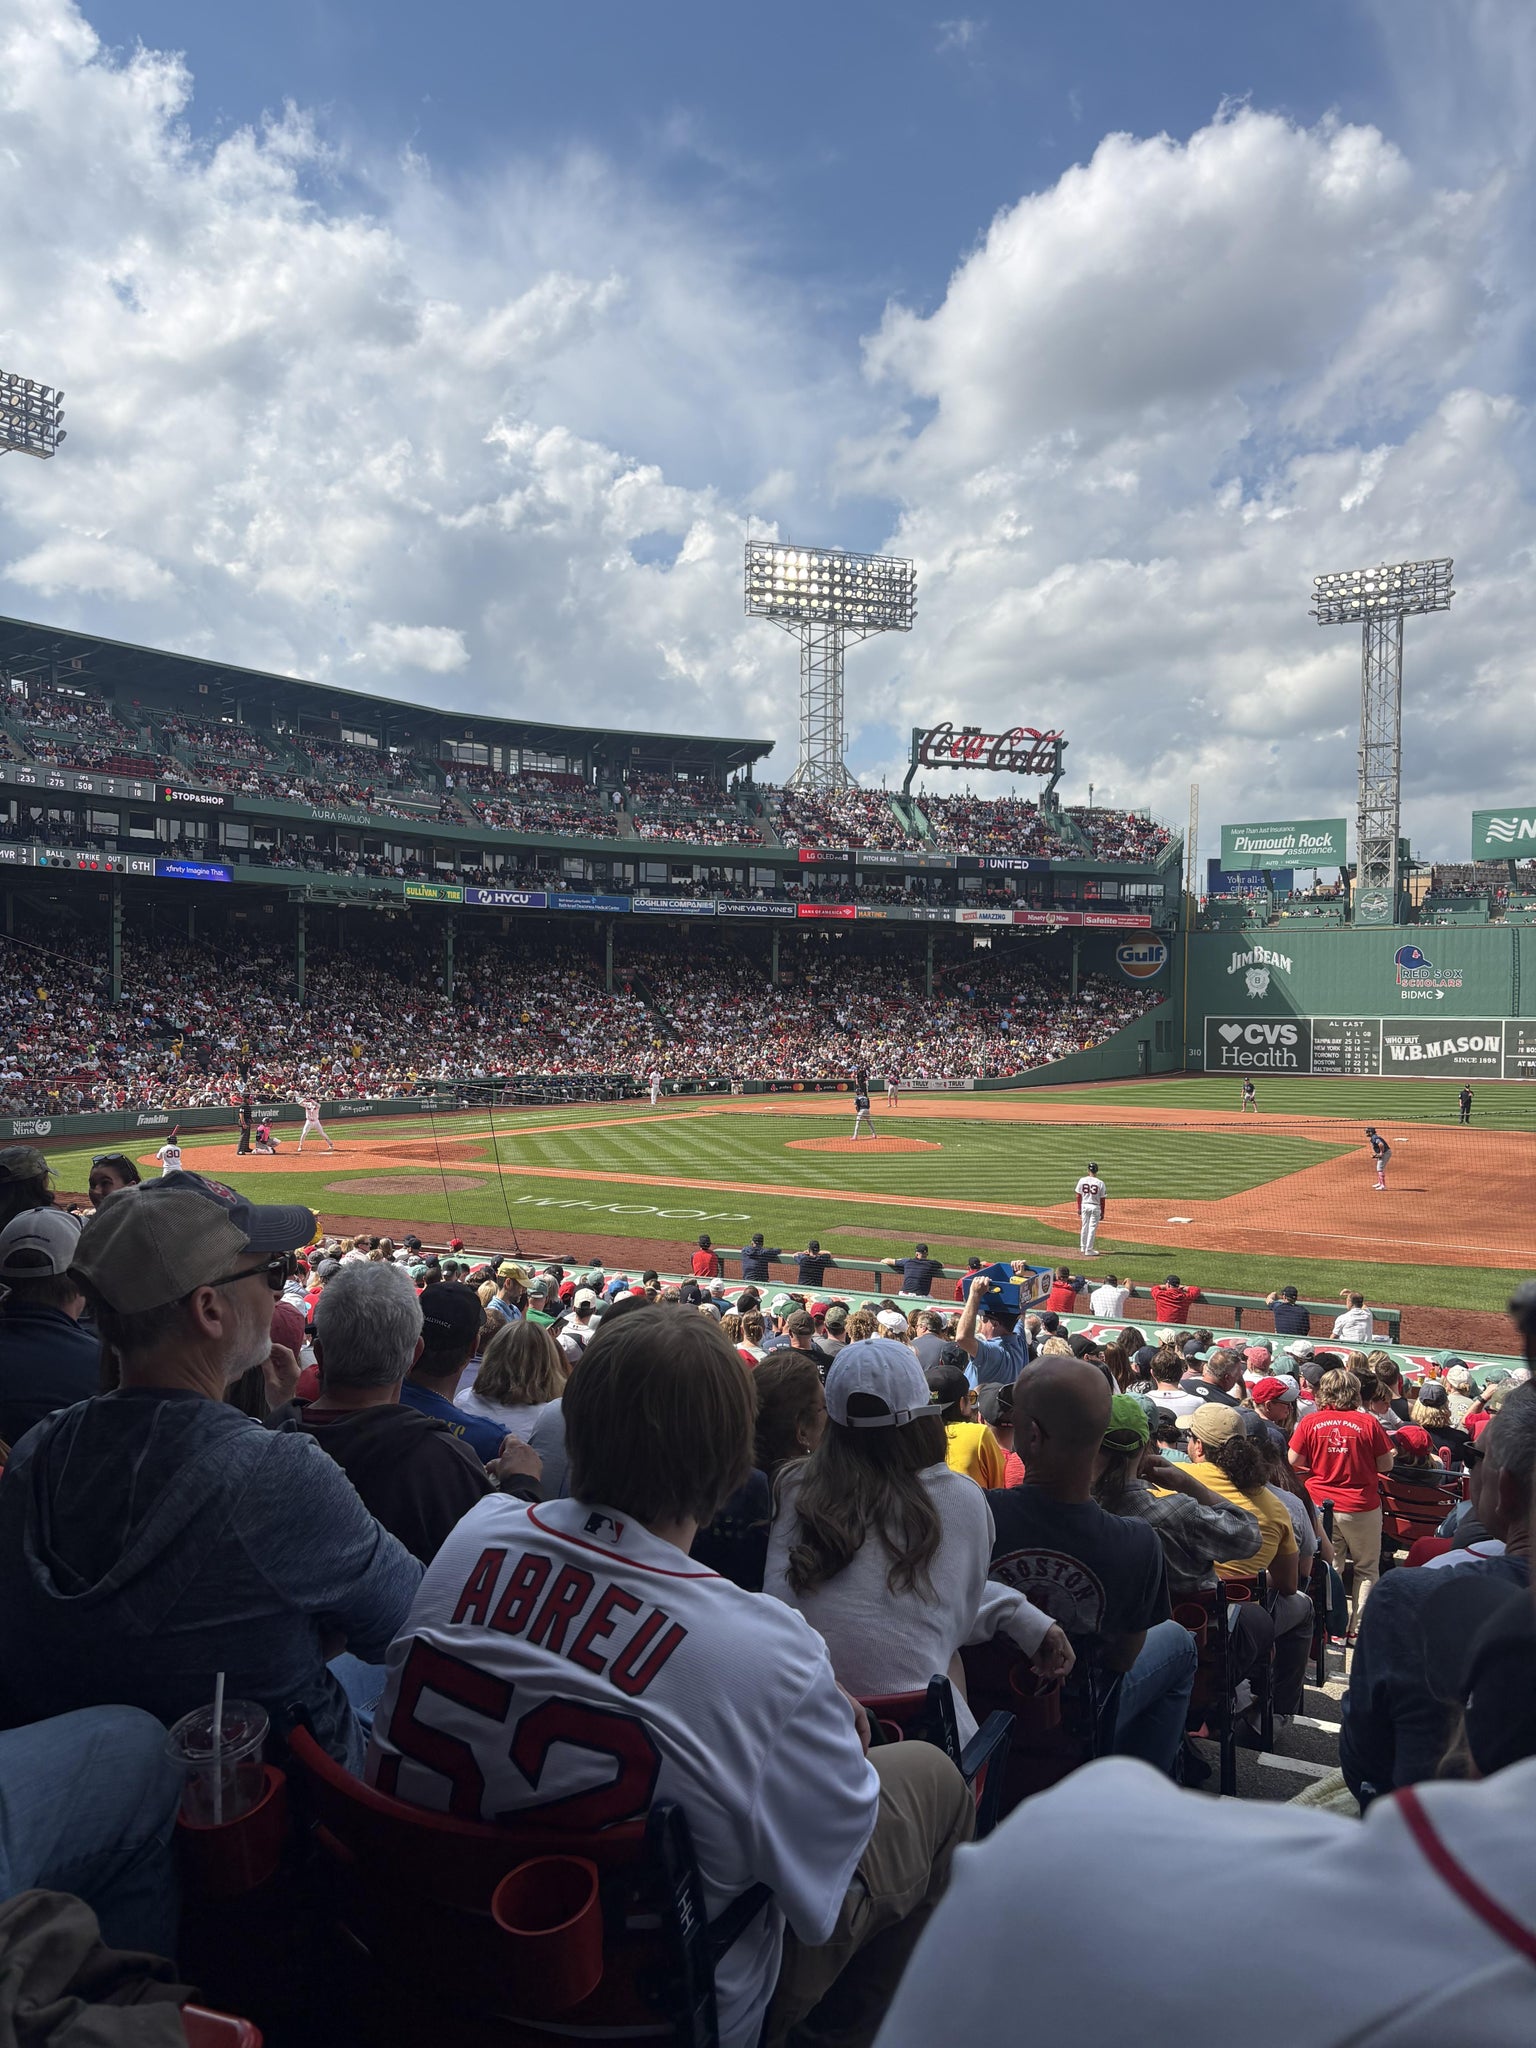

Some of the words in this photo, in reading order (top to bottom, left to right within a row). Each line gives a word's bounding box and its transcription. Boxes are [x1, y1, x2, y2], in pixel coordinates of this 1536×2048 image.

[17, 774, 36, 784] .233
[47, 778, 65, 787] .275
[75, 783, 93, 791] .508
[172, 791, 225, 805] STOP&SHOP
[337, 813, 371, 824] PAVILION
[1234, 834, 1296, 852] Plymouth
[1299, 832, 1333, 847] Rock
[45, 849, 65, 858] BALL
[76, 852, 100, 861] STRIKE
[107, 855, 121, 863] OUT
[131, 860, 150, 871] 6TH
[879, 855, 897, 863] BREAK
[990, 860, 1030, 870] UNITED
[165, 865, 186, 874] xfinity
[186, 866, 210, 876] Imagine
[210, 868, 224, 877] That
[1247, 874, 1277, 884] all-sr
[406, 886, 437, 898] SULLIVAN
[447, 891, 461, 899] TIRE
[495, 893, 530, 904] HYCU
[634, 899, 668, 907] COGHLIN
[669, 900, 714, 909] COMPANIES
[979, 912, 1006, 921] AMAZING
[1086, 916, 1118, 925] Safelite
[1117, 946, 1164, 962] Gulf
[1226, 951, 1254, 975] JIM
[1253, 945, 1294, 975] BEAM
[1401, 969, 1430, 978] RED
[1433, 969, 1463, 978] SOX
[1401, 979, 1463, 988] SCHOLARS
[1401, 990, 1433, 999] BIDMC
[1244, 1023, 1298, 1046] CVS
[1385, 1036, 1403, 1044] WHO
[1404, 1036, 1419, 1044] BUT
[1188, 1048, 1202, 1057] 310
[1221, 1046, 1299, 1068] Health
[251, 1108, 280, 1118] artwater
[352, 1105, 373, 1114] TICKET
[12, 1120, 36, 1128] Ninety
[12, 1127, 35, 1135] Nine
[166, 1149, 180, 1158] 30
[1082, 1183, 1099, 1195] 83
[512, 1194, 752, 1221] WHOOP
[1313, 1419, 1342, 1433] FENWAY
[1342, 1420, 1363, 1433] PARK
[1327, 1446, 1349, 1454] STAFF
[996, 1556, 1097, 1602] BOSTON
[450, 1547, 689, 1697] ABREU
[374, 1634, 664, 1833] 52
